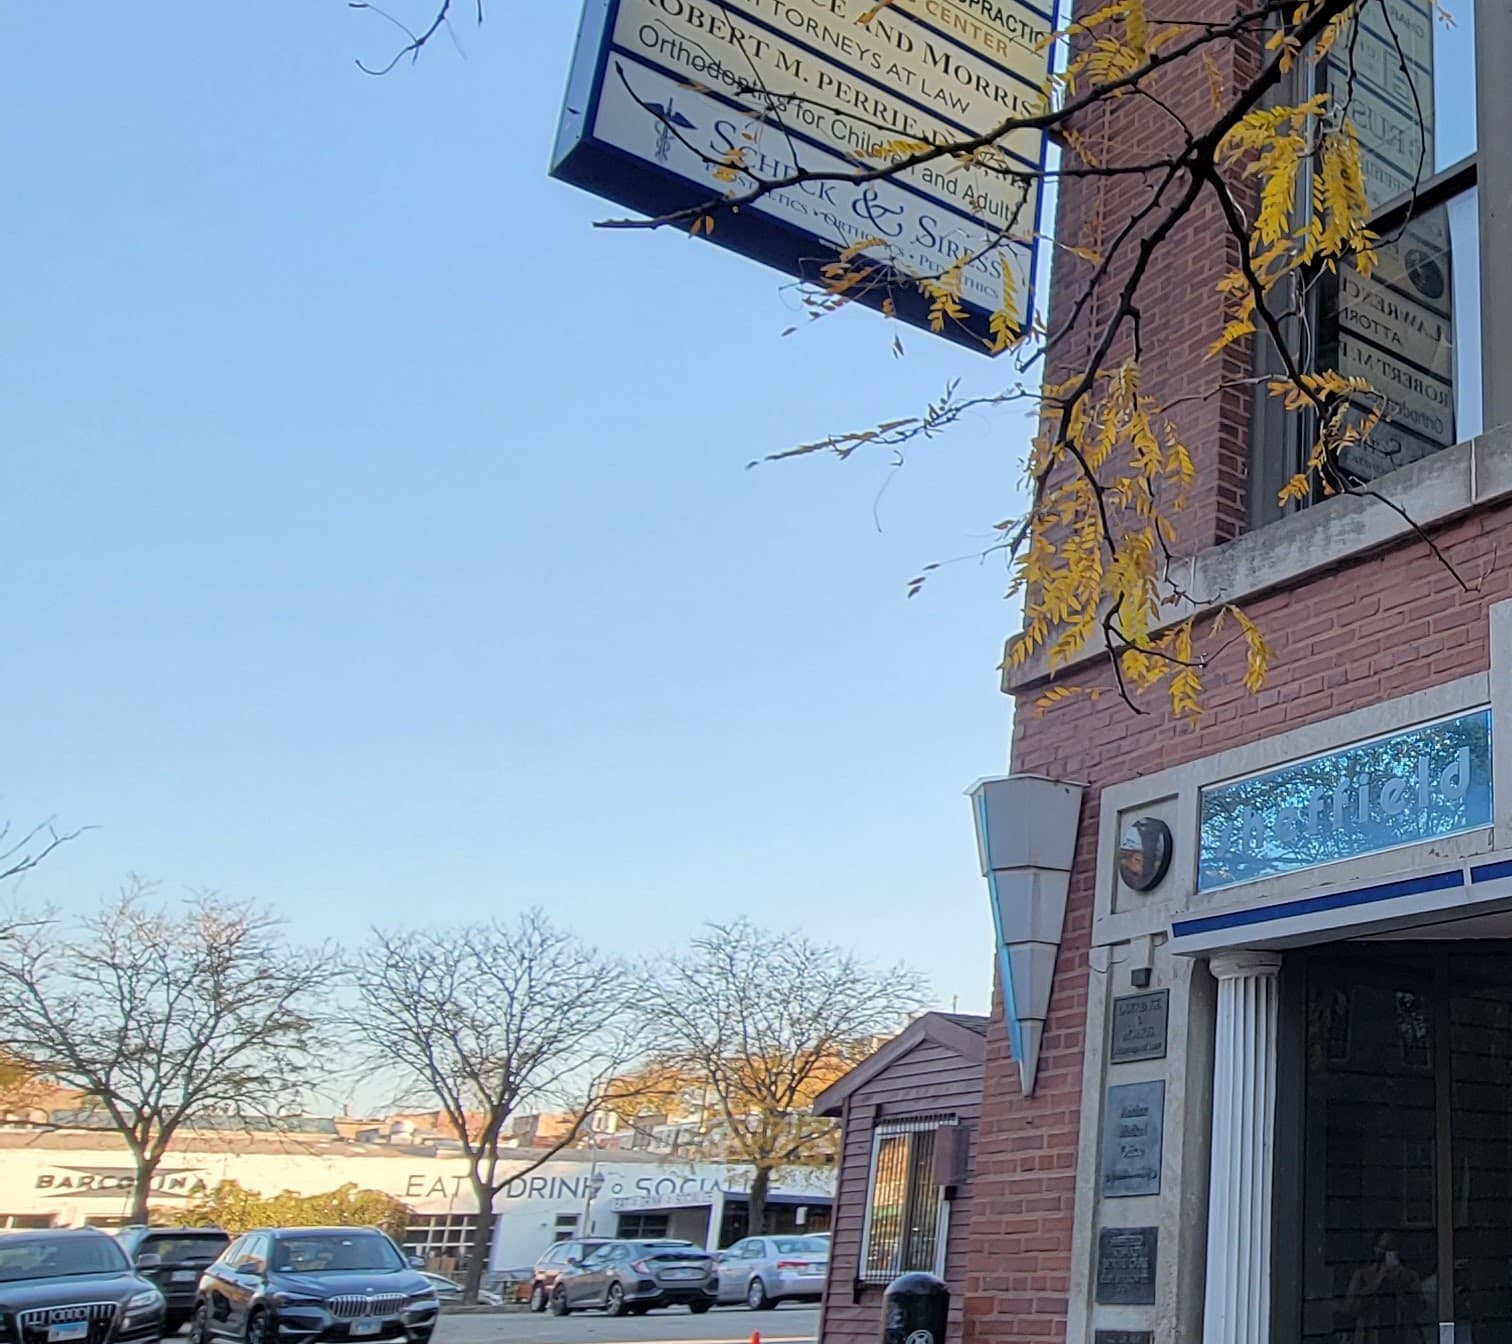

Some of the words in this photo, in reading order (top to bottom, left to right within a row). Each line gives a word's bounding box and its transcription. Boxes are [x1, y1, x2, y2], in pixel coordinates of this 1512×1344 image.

[926, 0, 1008, 57] CENTER
[775, 49, 808, 82] M.
[886, 63, 917, 85] AT
[921, 78, 971, 115] LAW
[922, 43, 1034, 116] MORRIS
[795, 99, 826, 129] for
[831, 120, 915, 177] Childre
[921, 167, 958, 196] and
[962, 184, 1019, 225] Adults
[852, 189, 903, 236] &
[1214, 746, 1471, 858] sheffield
[36, 1174, 207, 1190] BARCOINA
[406, 1175, 472, 1198] EAT
